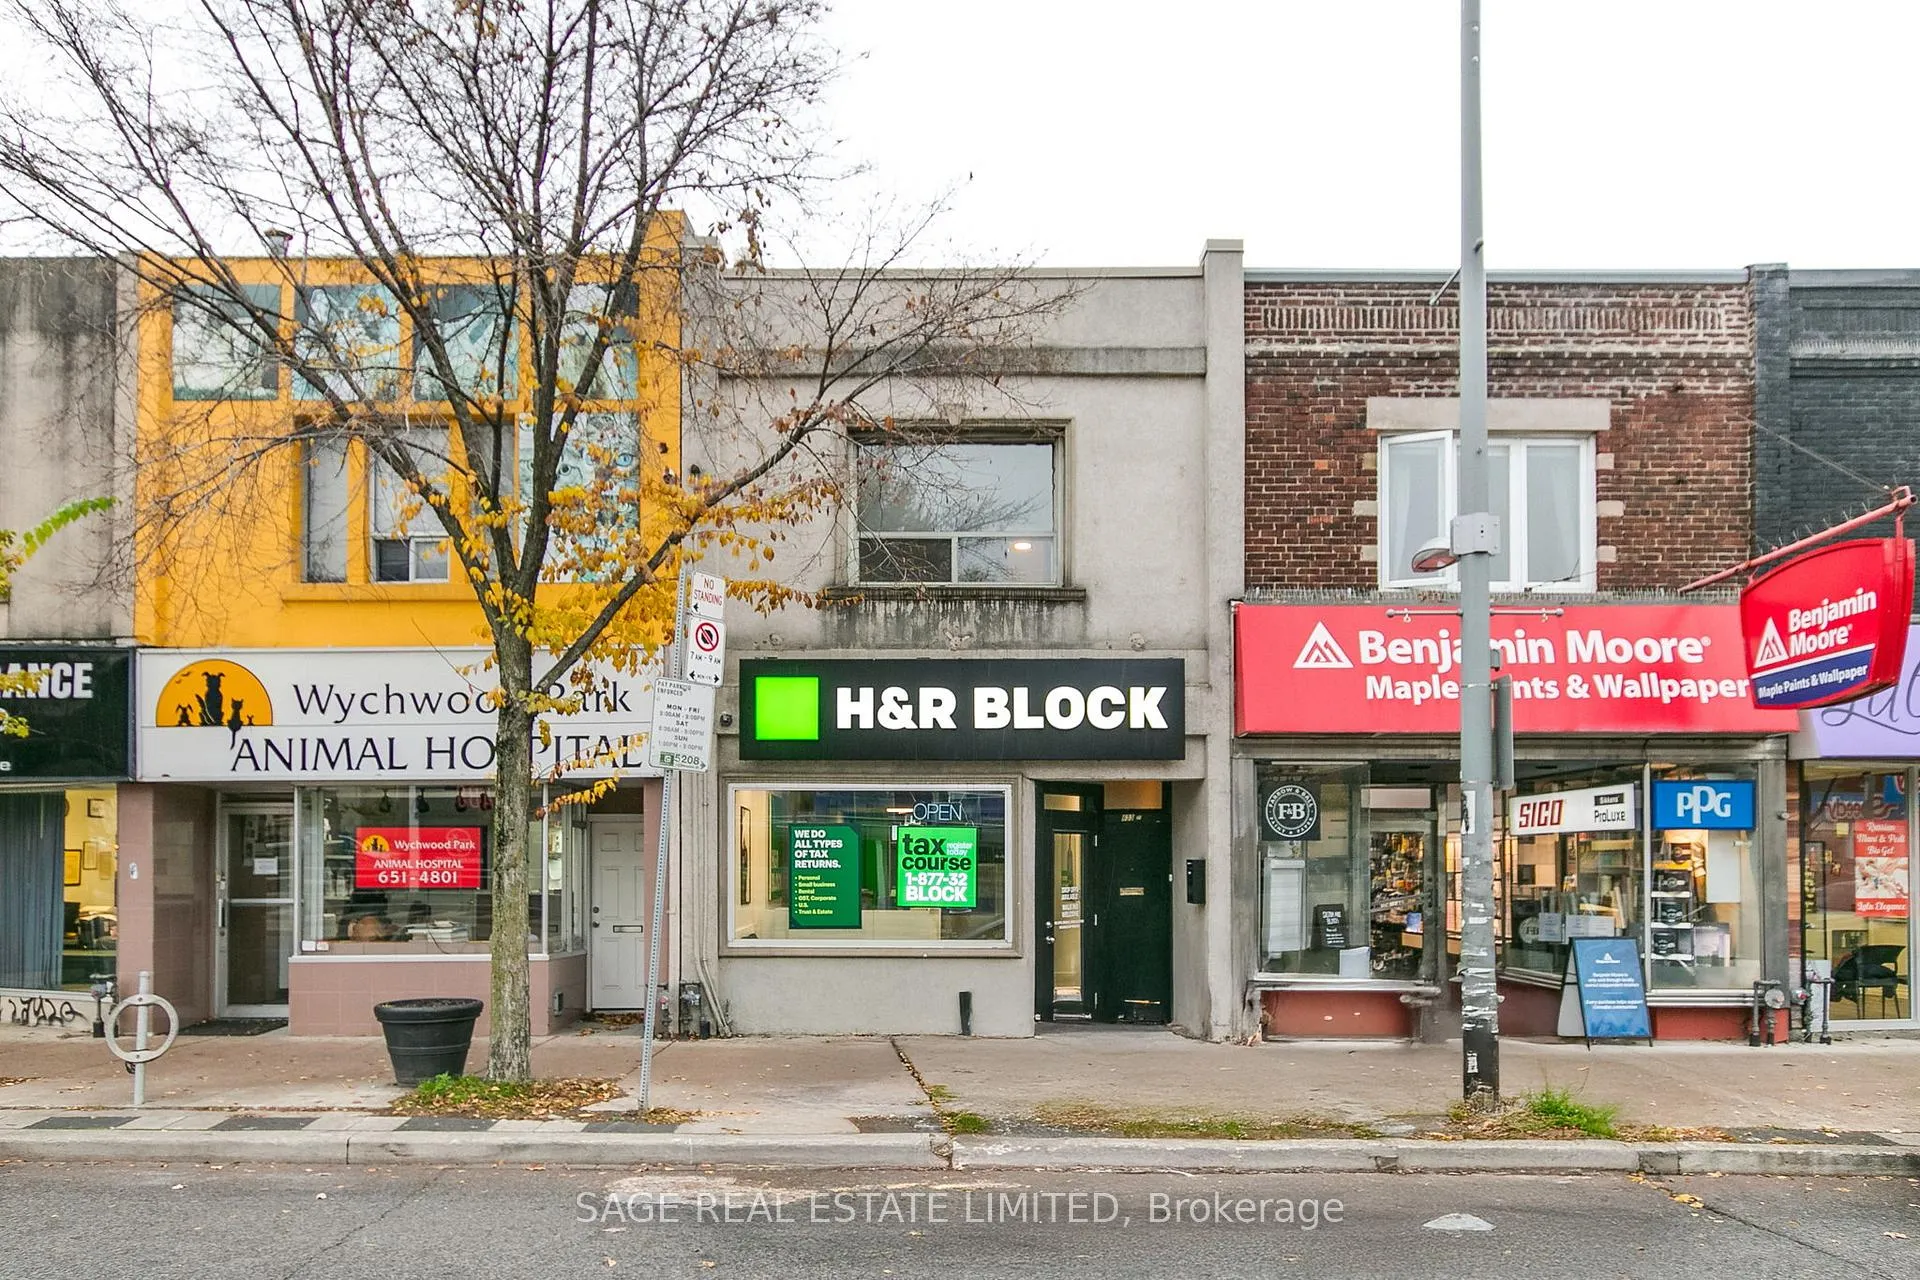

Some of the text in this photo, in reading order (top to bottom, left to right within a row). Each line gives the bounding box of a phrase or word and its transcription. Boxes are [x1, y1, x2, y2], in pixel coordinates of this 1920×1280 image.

[704, 578, 714, 590] NO
[693, 589, 723, 607] STANDING
[1788, 587, 1877, 633] Benjamin
[0, 662, 94, 698] ANCE
[1366, 674, 1460, 705] Maple
[1566, 674, 1591, 699] &
[1592, 672, 1750, 704] Wallpaper
[1758, 665, 1868, 699] Maple Paints & Wallpaper
[293, 683, 497, 724] Wychwoo
[836, 686, 1169, 730] H&R BLOCK
[231, 735, 642, 771] ANIMAL HOPITAL
[674, 753, 700, 766] 5208
[913, 802, 962, 821] OPEN
[1278, 803, 1306, 820] F&B
[1677, 785, 1731, 824] PPG
[1519, 799, 1564, 829] SICO
[1594, 808, 1626, 823] ProLuxe
[794, 830, 827, 838] WE DO
[394, 840, 476, 852] Wychwood Park
[794, 840, 843, 849] ALL TYPES
[902, 834, 948, 855] tax
[794, 849, 829, 859] OF TAX
[374, 859, 464, 869] ANIMAL HOSPITAL
[901, 856, 972, 871] course
[905, 872, 968, 887] 1-877-32
[905, 886, 968, 902] BLOCK
